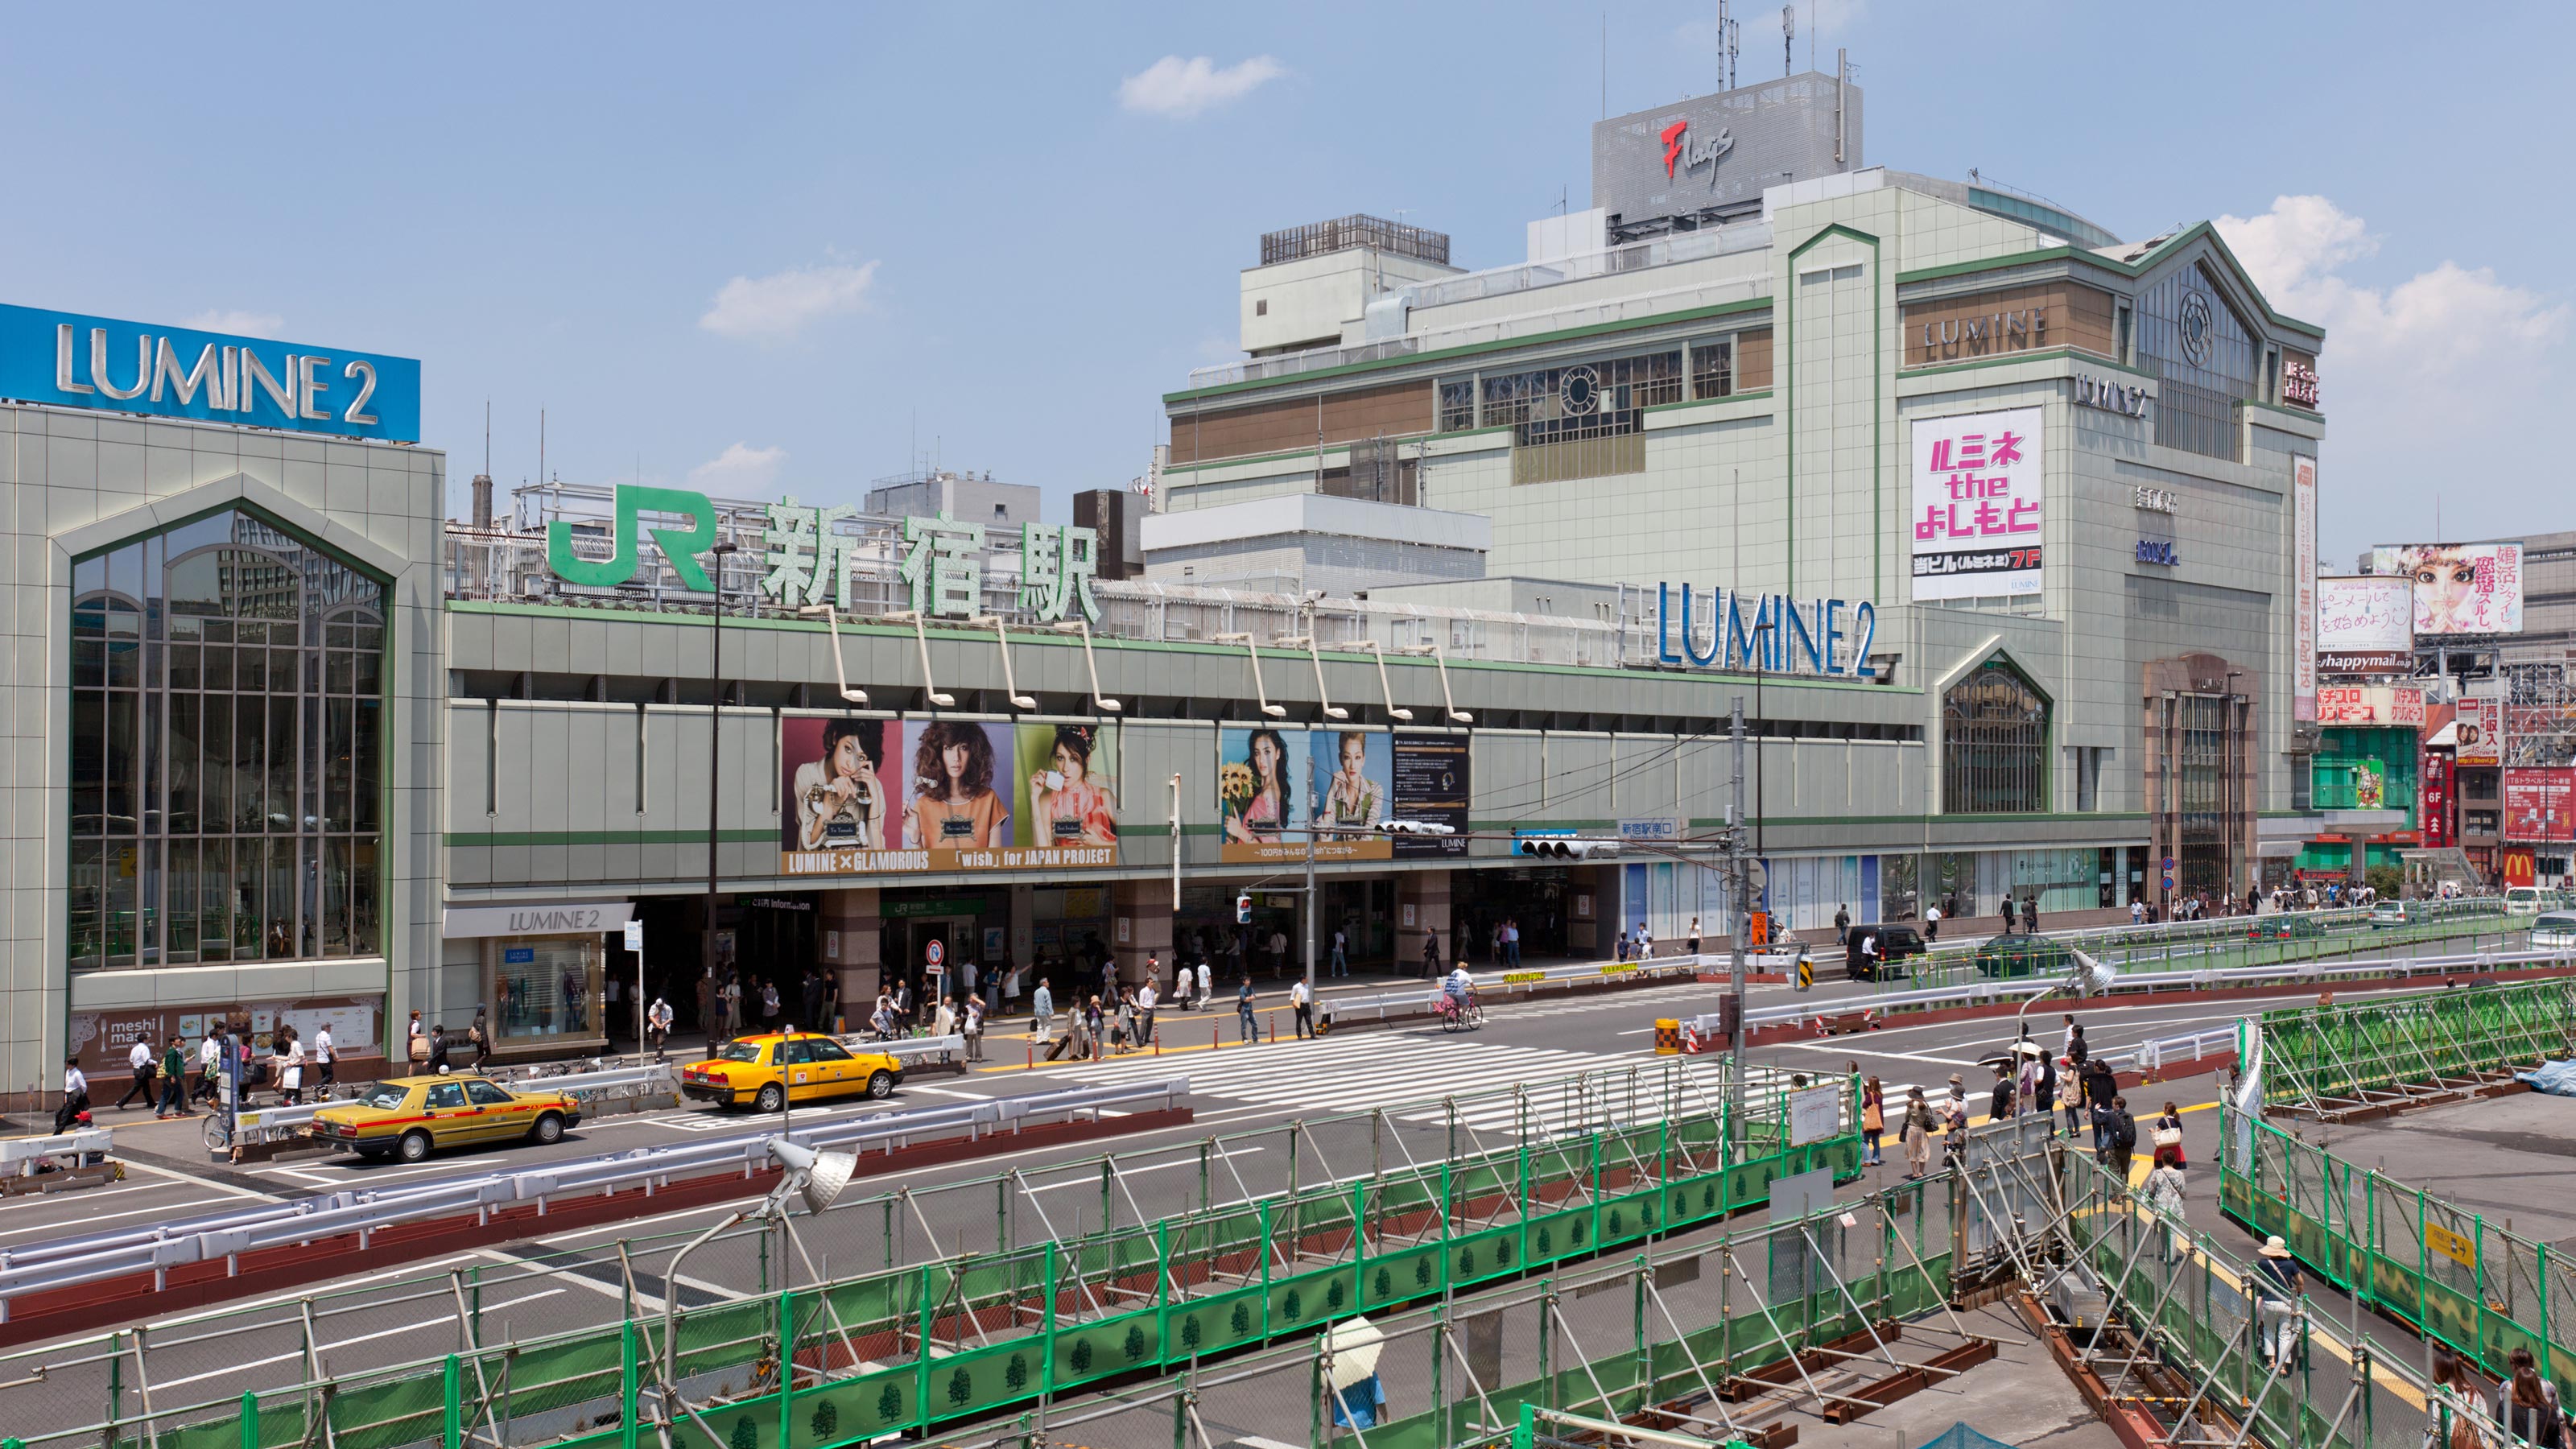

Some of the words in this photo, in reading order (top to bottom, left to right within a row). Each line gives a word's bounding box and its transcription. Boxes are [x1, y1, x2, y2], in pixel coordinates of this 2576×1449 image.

[1660, 121, 1735, 184] Flags
[1925, 307, 2046, 347] LUMINE
[56, 324, 332, 420] LUMINE
[344, 360, 378, 425] 2
[2076, 373, 2136, 415] LUMINE
[2138, 387, 2147, 418] 2
[1930, 431, 2024, 473] ルミネ
[1944, 472, 2008, 500] the
[1915, 497, 2040, 540] よしもと
[547, 484, 716, 592] JR
[761, 495, 1103, 625] 新宿駅
[2009, 549, 2041, 568] 7F
[2011, 580, 2039, 589] LUMINE
[1657, 581, 1845, 675] LUMINE
[1854, 601, 1876, 677] 2
[2300, 588, 2311, 688] 無料配送
[2394, 689, 2421, 704] パチスロ
[2486, 705, 2498, 746] 高収入
[2428, 792, 2442, 803] 6F
[1622, 823, 1672, 835] 新宿駅南口
[1442, 838, 1466, 848] LUMINE
[789, 852, 836, 873] LUMINE
[853, 850, 929, 872] GLAMOROUS
[1004, 851, 1022, 866] for
[1025, 849, 1060, 865] JAPAN
[1063, 848, 1112, 864] PROJECT
[894, 903, 908, 913] JR
[1757, 915, 1766, 924] 50
[509, 910, 585, 931] LUMINE
[587, 910, 600, 927] 2
[110, 1018, 156, 1033] meshi
